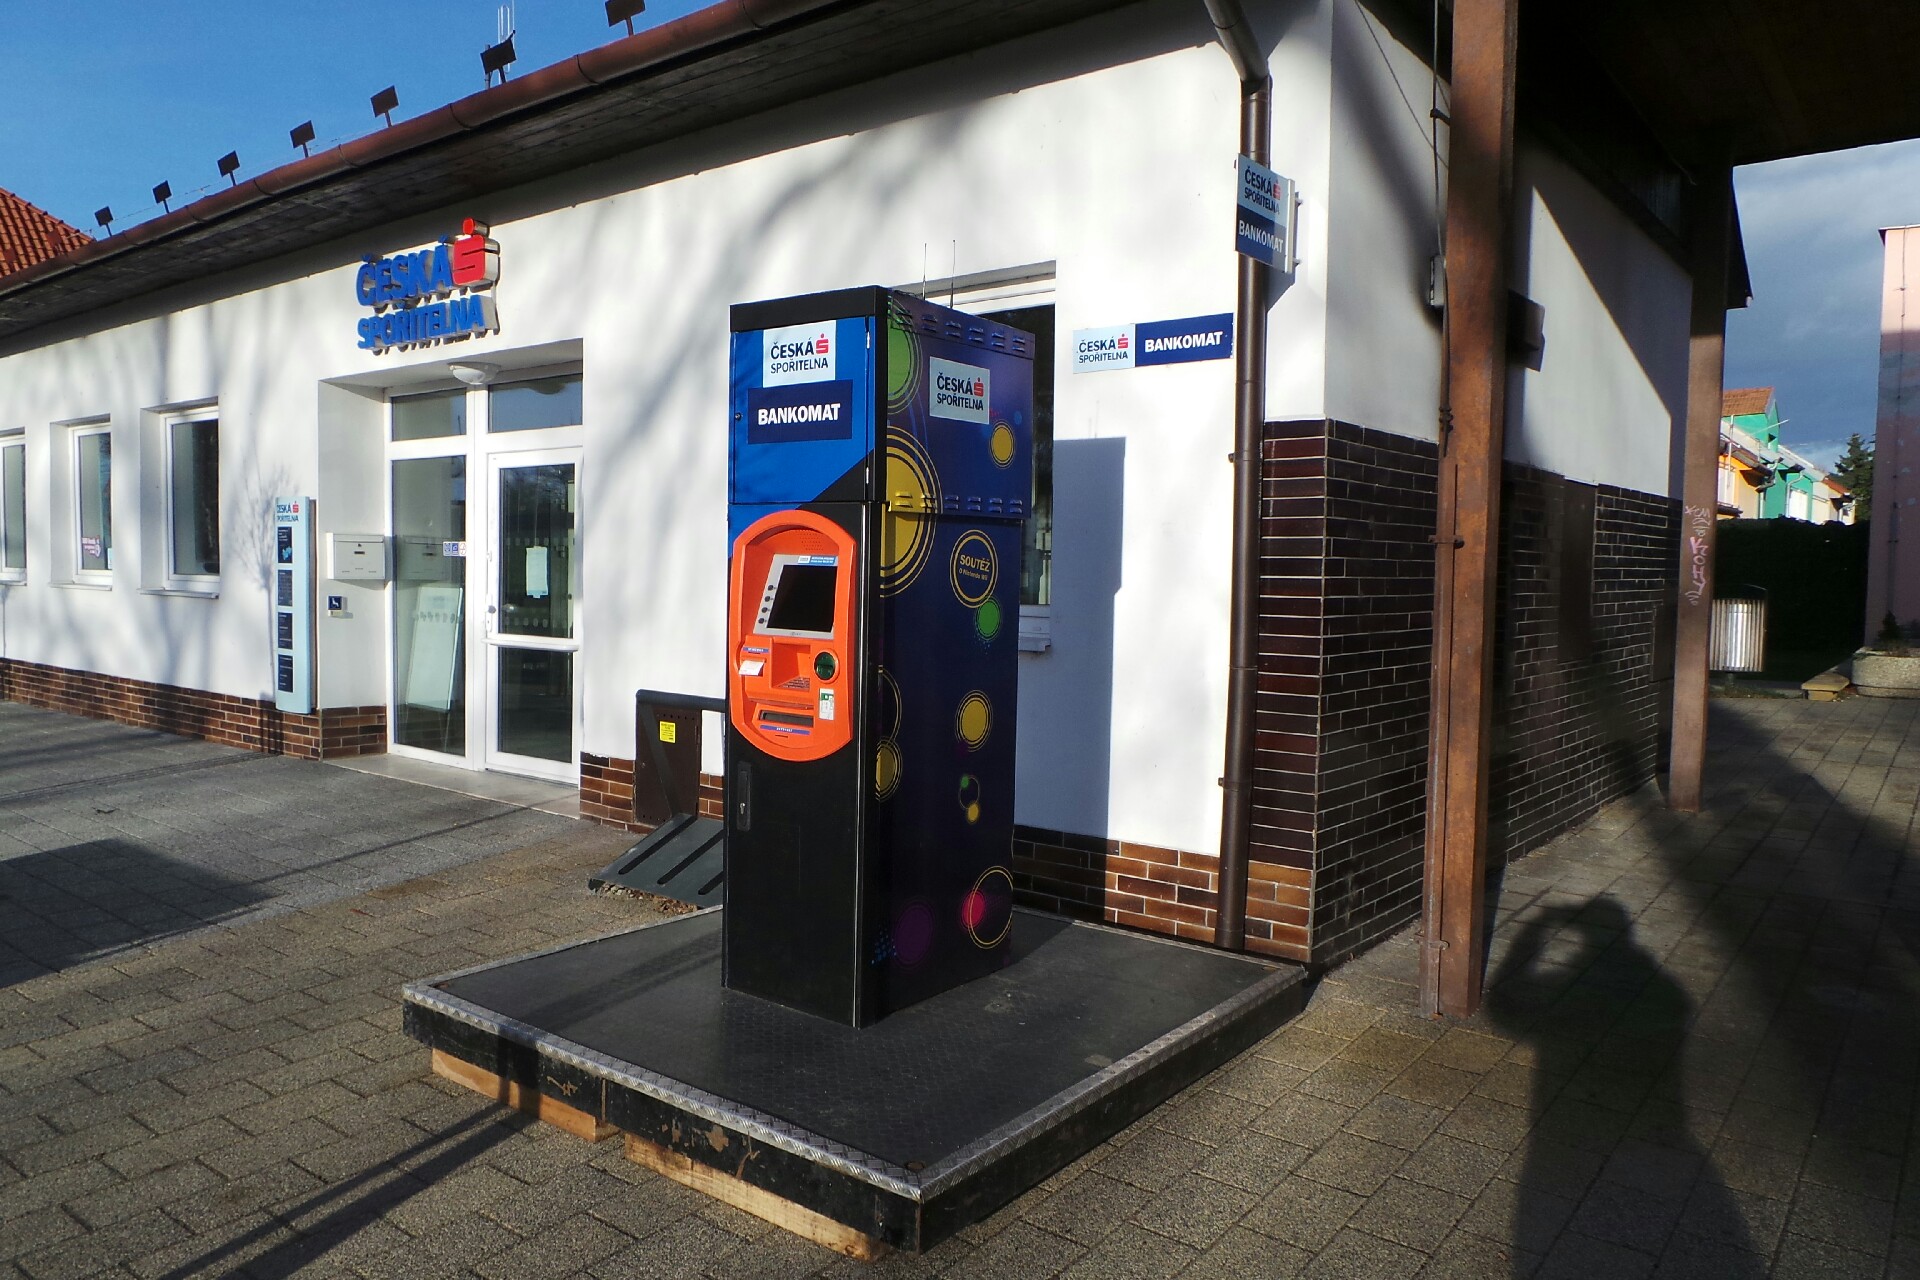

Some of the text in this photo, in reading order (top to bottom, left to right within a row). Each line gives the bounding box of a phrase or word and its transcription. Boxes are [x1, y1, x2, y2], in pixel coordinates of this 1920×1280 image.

[1245, 166, 1272, 196] ČESKÁ
[1245, 187, 1280, 216] SPOŘITELNA
[1239, 220, 1284, 253] BANKOMAT
[356, 235, 453, 306] ČESKÁ
[357, 295, 486, 350] SPOŘITELNA
[770, 336, 815, 360] ČESKÁ
[1079, 336, 1116, 353] ČESKÁ
[1144, 331, 1224, 353] BANKOMAT
[770, 356, 829, 374] SPOŘITELNA
[1079, 350, 1129, 364] SPOŘITELNA
[936, 371, 973, 396] ČESKÁ
[936, 392, 984, 411] SPOŘITELNA
[757, 402, 842, 426] BANKOMAT
[959, 553, 991, 572] SOUTĚŽ
